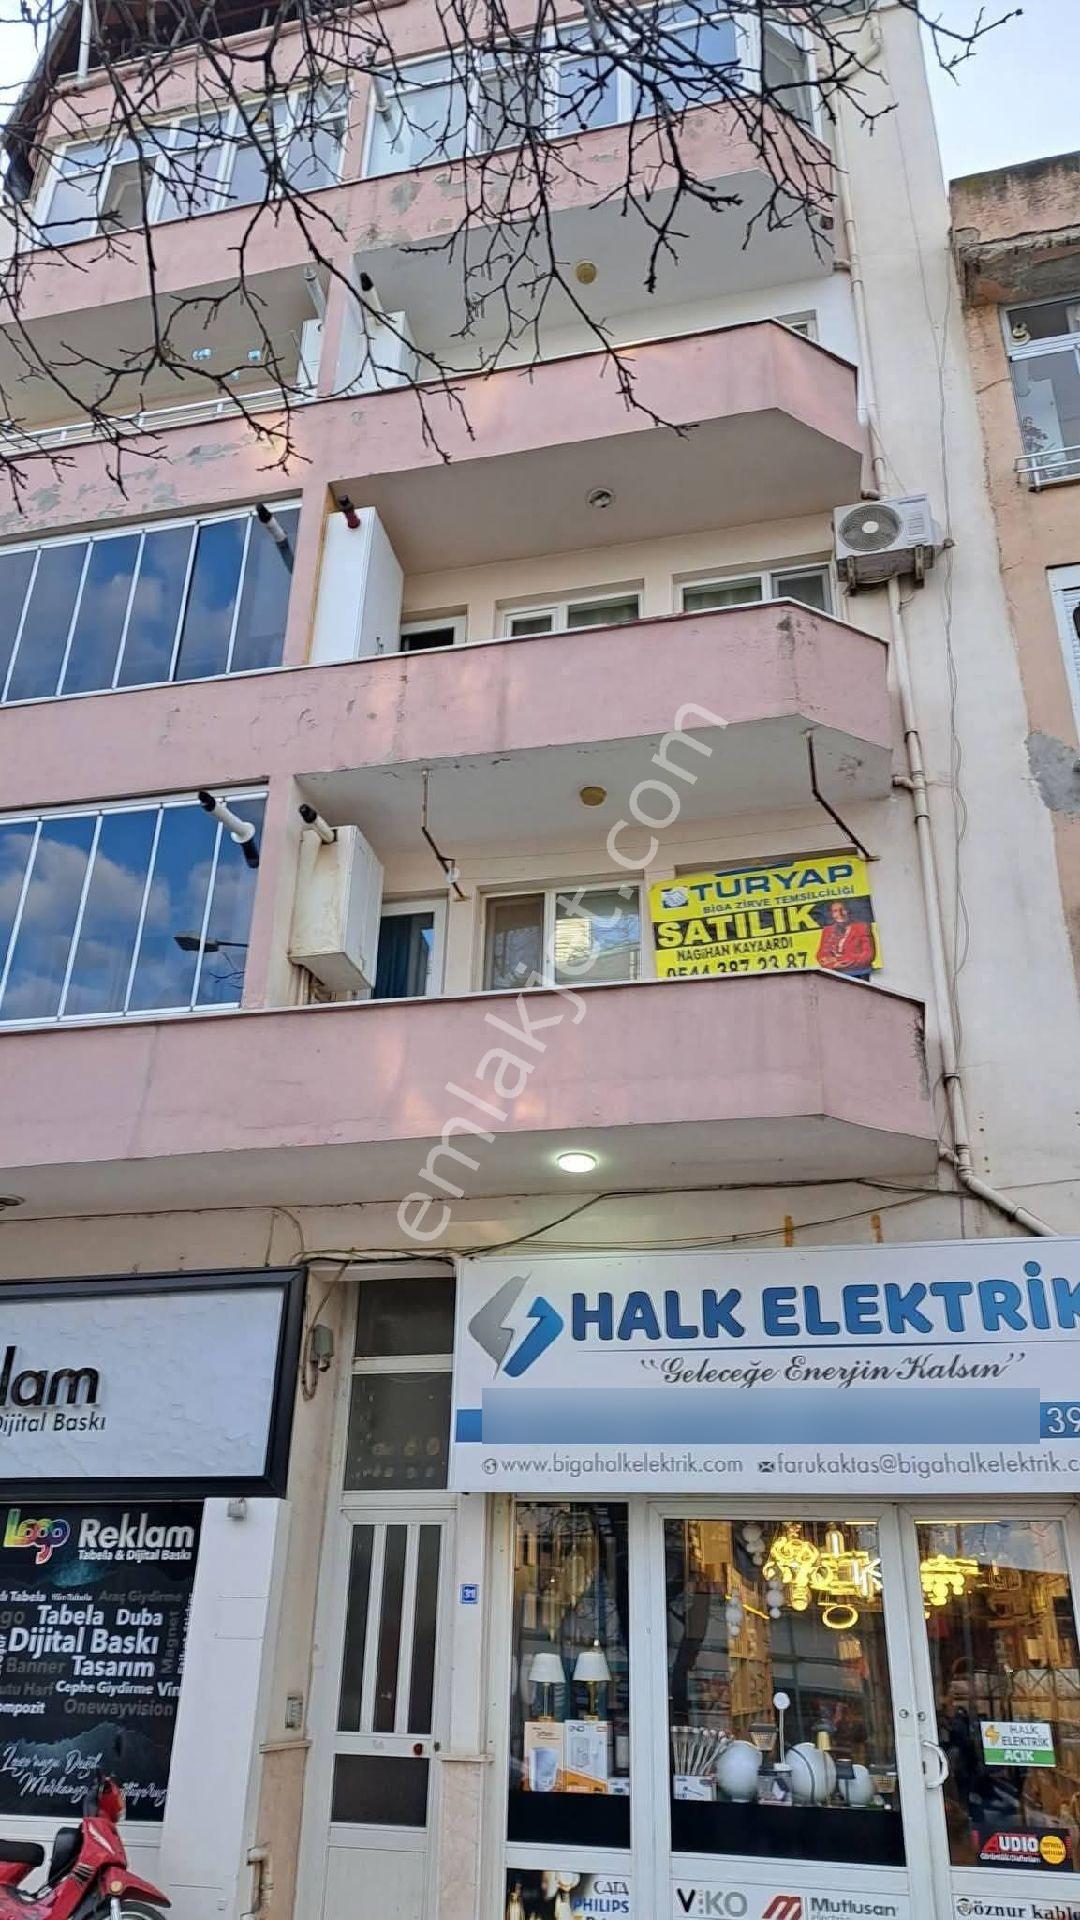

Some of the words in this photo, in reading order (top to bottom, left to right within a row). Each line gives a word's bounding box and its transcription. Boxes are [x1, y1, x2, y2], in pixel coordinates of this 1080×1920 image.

[690, 864, 853, 901] TURYAP
[657, 903, 821, 948] SATILIK
[571, 1287, 745, 1341] HALK
[784, 1355, 898, 1388] Enerjin
[53, 1411, 106, 1432] Baskı
[501, 1452, 743, 1478] www.bigahalkelektrik.com
[78, 1513, 195, 1548] Reklam
[37, 1604, 104, 1626] Tabela
[115, 1607, 164, 1626] Duba
[8, 1627, 86, 1659] Dijital
[90, 1627, 159, 1655] Baskı
[6, 1657, 67, 1673] Banner
[71, 1655, 155, 1678] Tasarım
[64, 1698, 173, 1718] Onewayvision
[572, 1897, 630, 1914] PHILIPS
[810, 1896, 896, 1917] Mutlusan
[973, 1900, 1026, 1918] öznur
